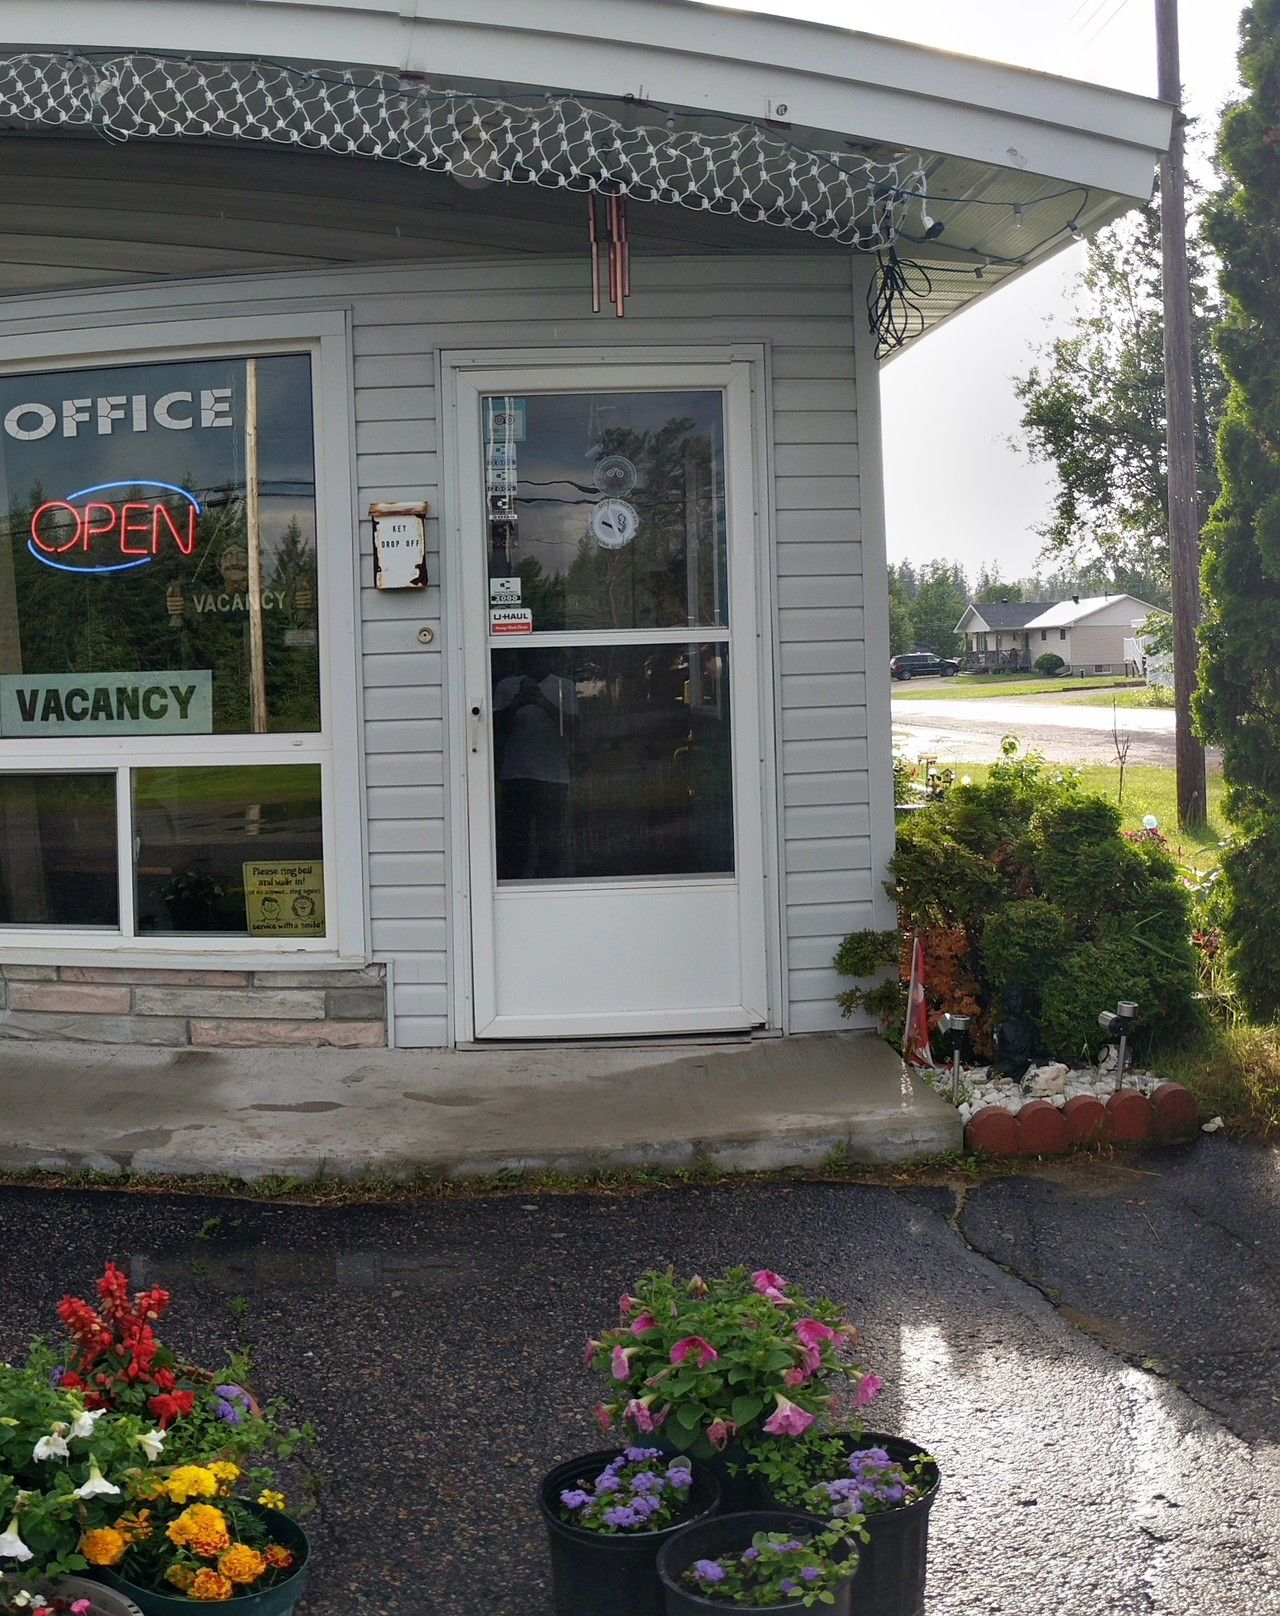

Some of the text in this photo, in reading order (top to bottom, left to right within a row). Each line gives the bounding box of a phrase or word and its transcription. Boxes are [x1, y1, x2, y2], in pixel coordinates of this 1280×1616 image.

[4, 388, 233, 441] OFFICE
[30, 500, 197, 556] OPEN
[392, 525, 406, 533] KEY
[381, 539, 419, 548] DROP OFF
[192, 591, 287, 614] VACANCY
[493, 612, 528, 620] U-HAUL
[15, 684, 198, 722] VACANCY
[252, 866, 312, 877] Please ring bell
[258, 877, 305, 886] and walk in!
[278, 921, 293, 929] with
[301, 919, 326, 929] smile!
